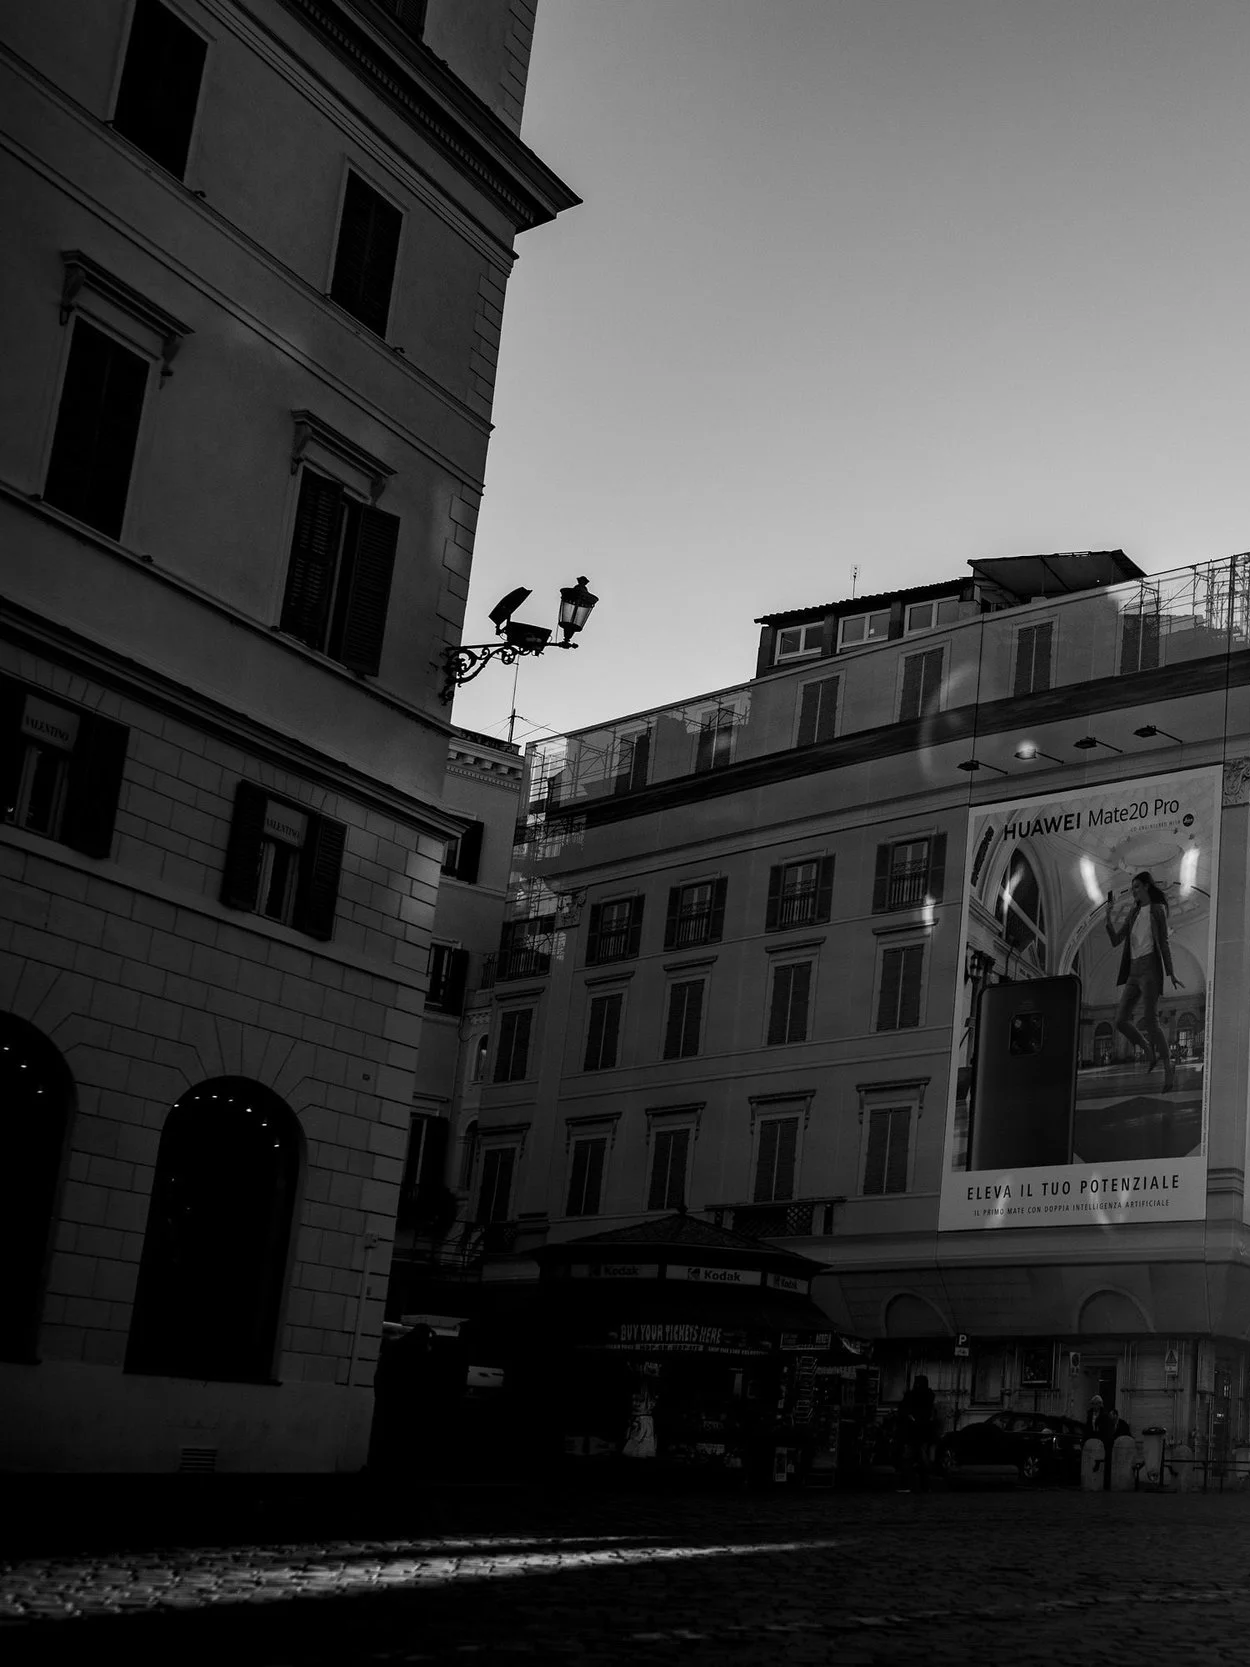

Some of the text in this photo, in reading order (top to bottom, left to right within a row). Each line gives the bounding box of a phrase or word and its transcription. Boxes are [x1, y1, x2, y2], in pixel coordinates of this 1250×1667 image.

[1003, 798, 1180, 841] HUAWEI Mate20 Pro
[967, 1175, 1180, 1200] ELEVA IL TUO POTENZIALE
[983, 1208, 1005, 1217] PRIMO
[1007, 1207, 1024, 1215] MATE
[1027, 1206, 1042, 1214] CON
[1044, 1204, 1070, 1213] DOPPIA
[1072, 1201, 1122, 1211] INTELLIGENZA
[1125, 1199, 1170, 1209] ARTIFICIALE
[603, 1265, 640, 1276] Kodak
[704, 1269, 741, 1282] Kodak
[781, 1278, 798, 1289] Kodak
[620, 1324, 723, 1344] BUY YOUR TICKETS HERE
[958, 1334, 967, 1345] P
